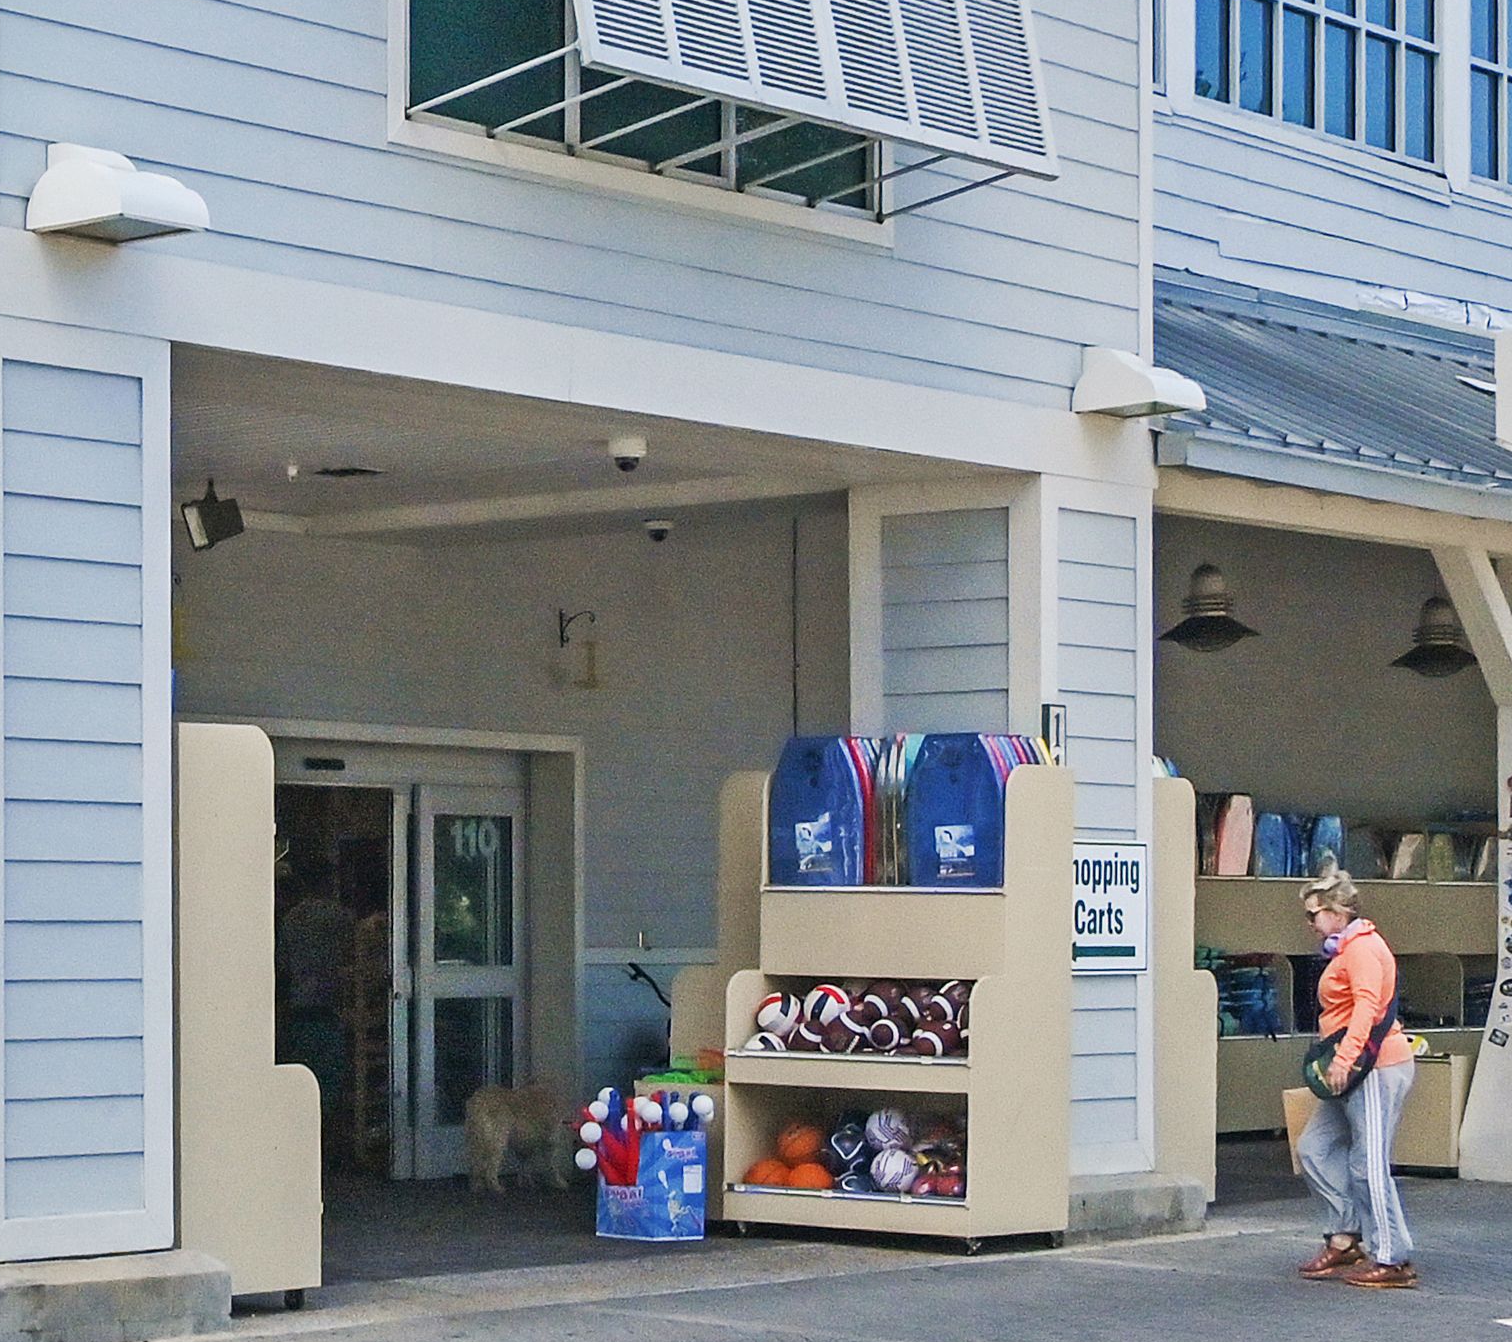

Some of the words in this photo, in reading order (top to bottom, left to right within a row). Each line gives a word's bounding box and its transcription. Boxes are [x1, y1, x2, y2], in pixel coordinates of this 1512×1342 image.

[450, 818, 498, 858] 110
[1072, 852, 1140, 894] opping
[1074, 899, 1124, 935] Carts
